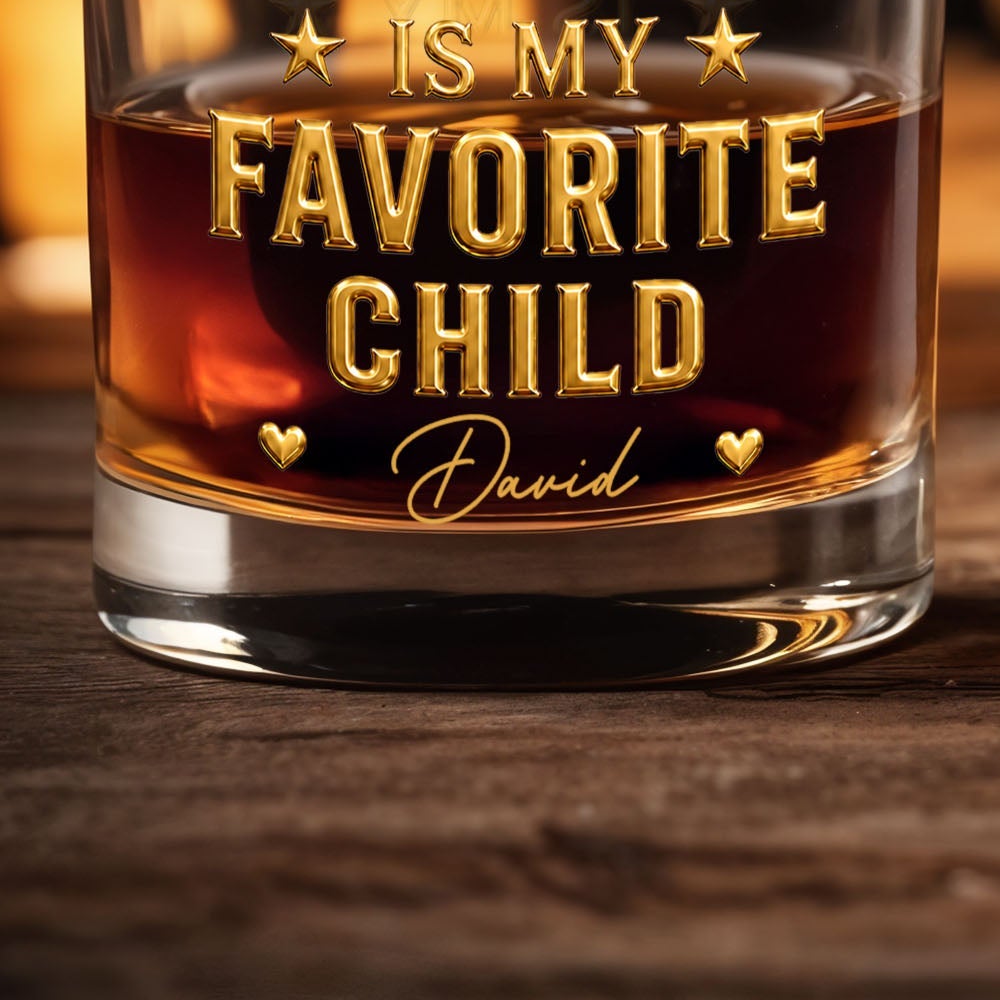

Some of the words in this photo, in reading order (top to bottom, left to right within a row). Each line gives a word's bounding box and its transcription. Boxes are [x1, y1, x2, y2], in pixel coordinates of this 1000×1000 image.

[389, 18, 475, 100] IS
[512, 16, 660, 101] MY
[207, 108, 828, 258] FAVORITE
[325, 275, 706, 400] CHILD
[391, 413, 643, 525] David
